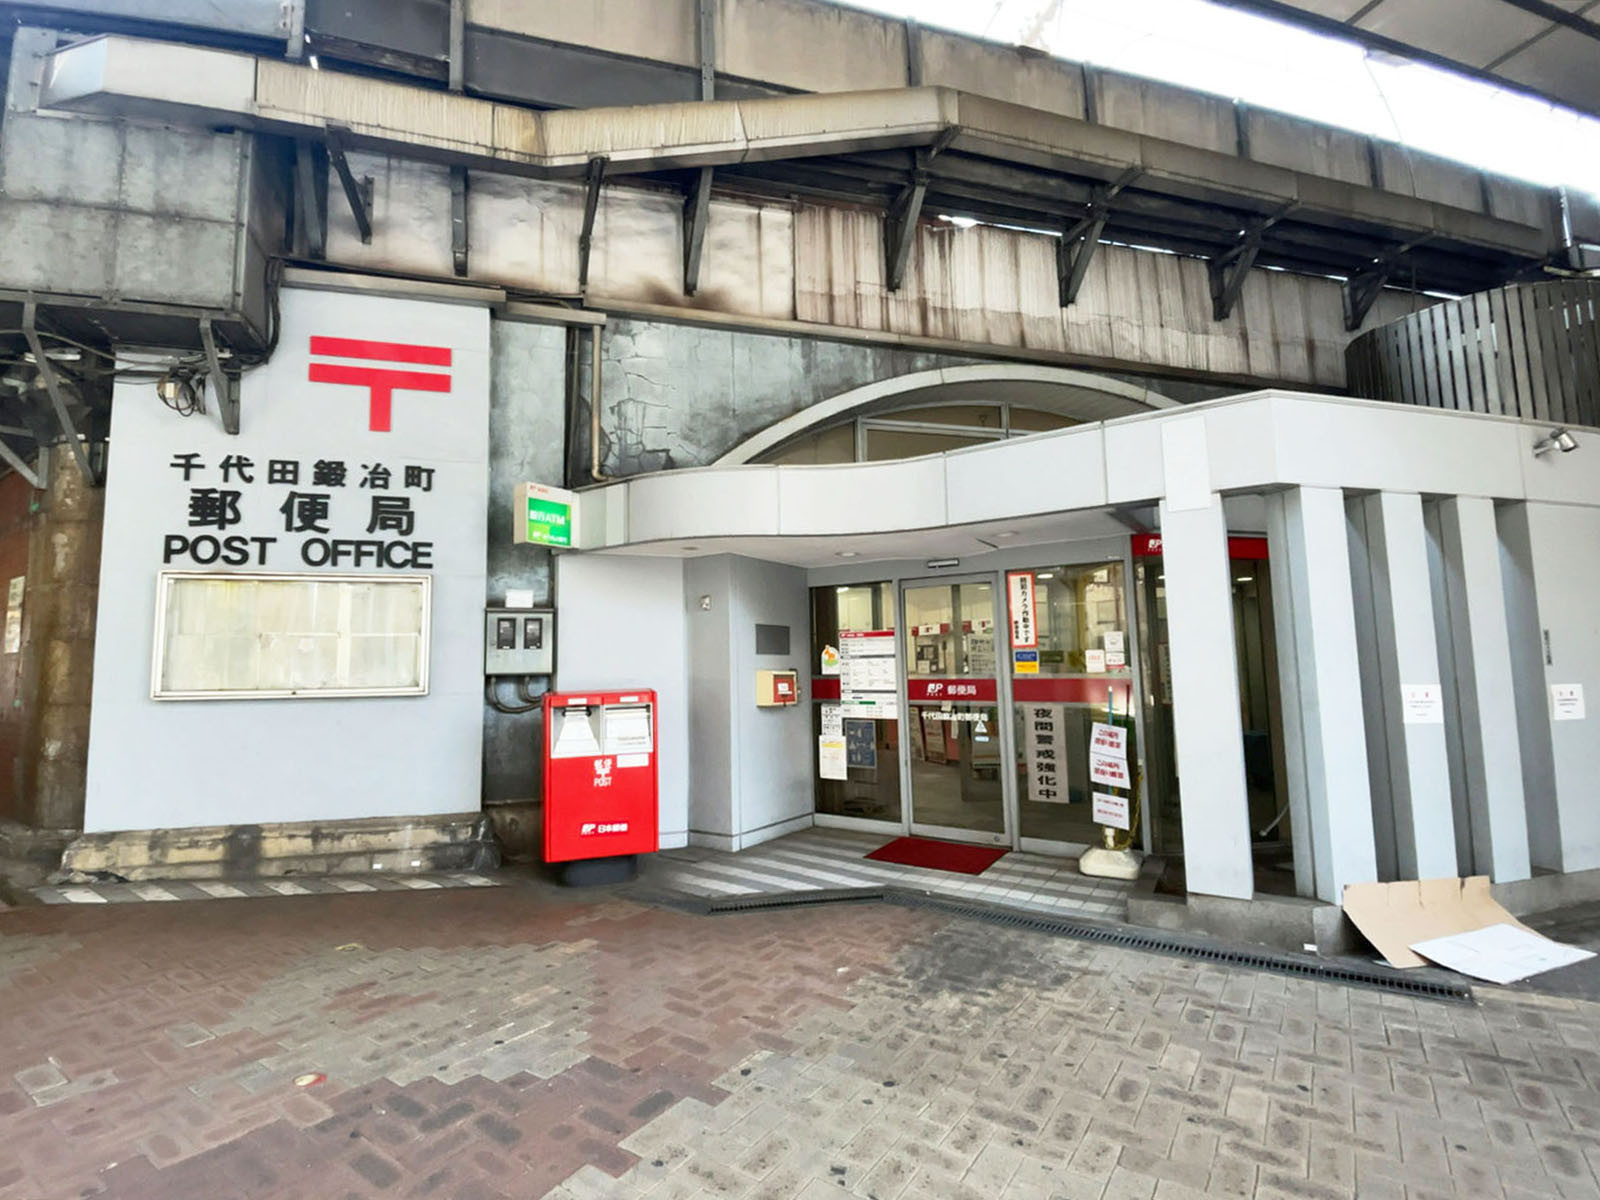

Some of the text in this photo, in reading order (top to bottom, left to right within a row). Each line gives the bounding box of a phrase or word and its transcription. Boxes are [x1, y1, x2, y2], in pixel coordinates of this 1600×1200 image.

[169, 453, 435, 491] 千代田鍛冶町
[188, 488, 415, 536] 郵便局
[163, 534, 434, 569] POST OFFICE
[947, 684, 977, 696] 郵便局
[1033, 708, 1057, 799] 夜間警戒強化中
